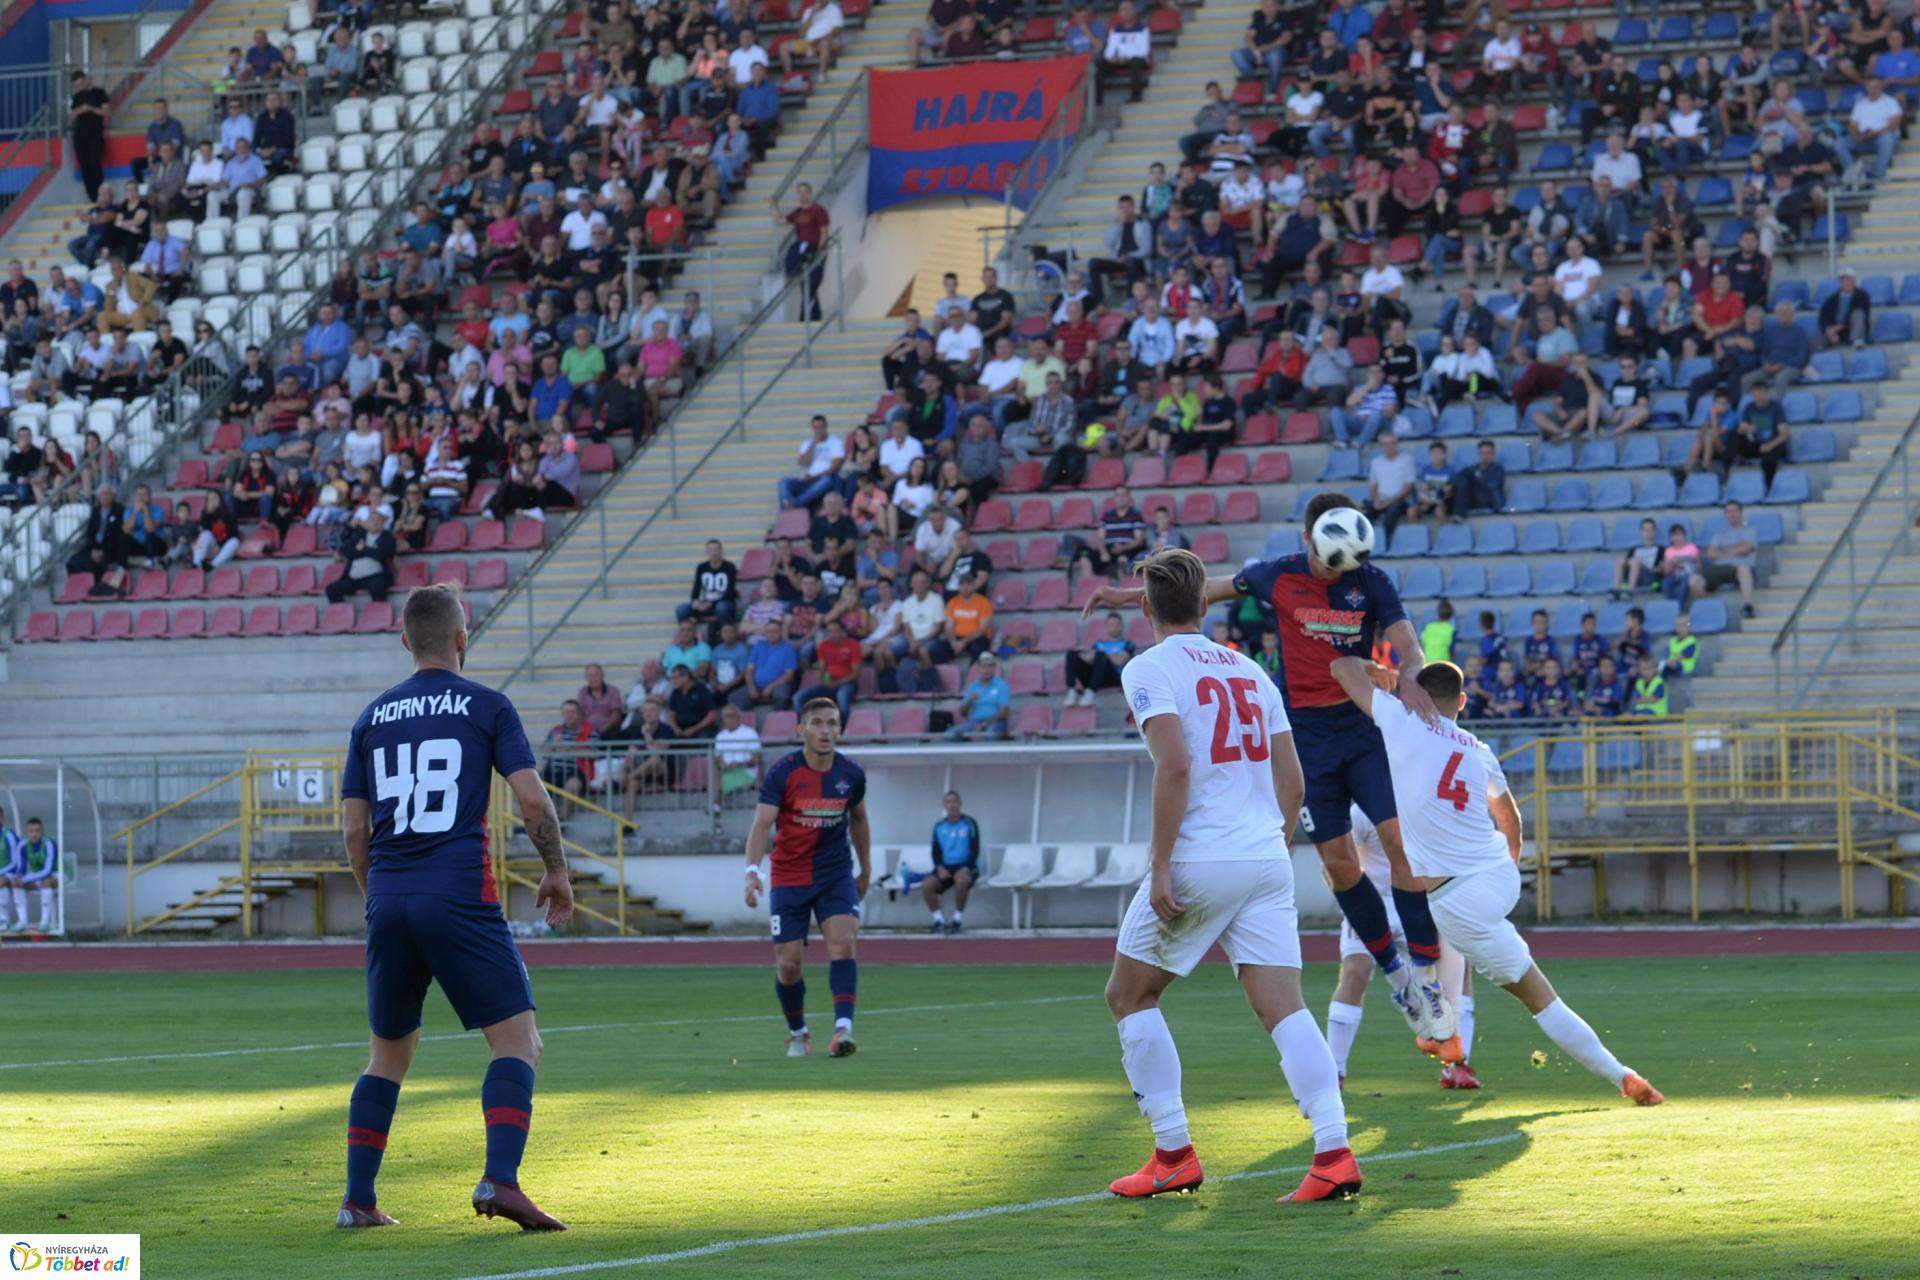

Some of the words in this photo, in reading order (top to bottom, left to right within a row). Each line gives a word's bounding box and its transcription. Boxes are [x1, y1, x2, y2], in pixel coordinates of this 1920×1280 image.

[912, 76, 1044, 132] HAJRÁ
[372, 689, 472, 726] HORNYÁK
[1196, 676, 1269, 765] 25
[304, 778, 317, 798] C
[373, 738, 462, 836] 48
[1437, 751, 1469, 812] 4
